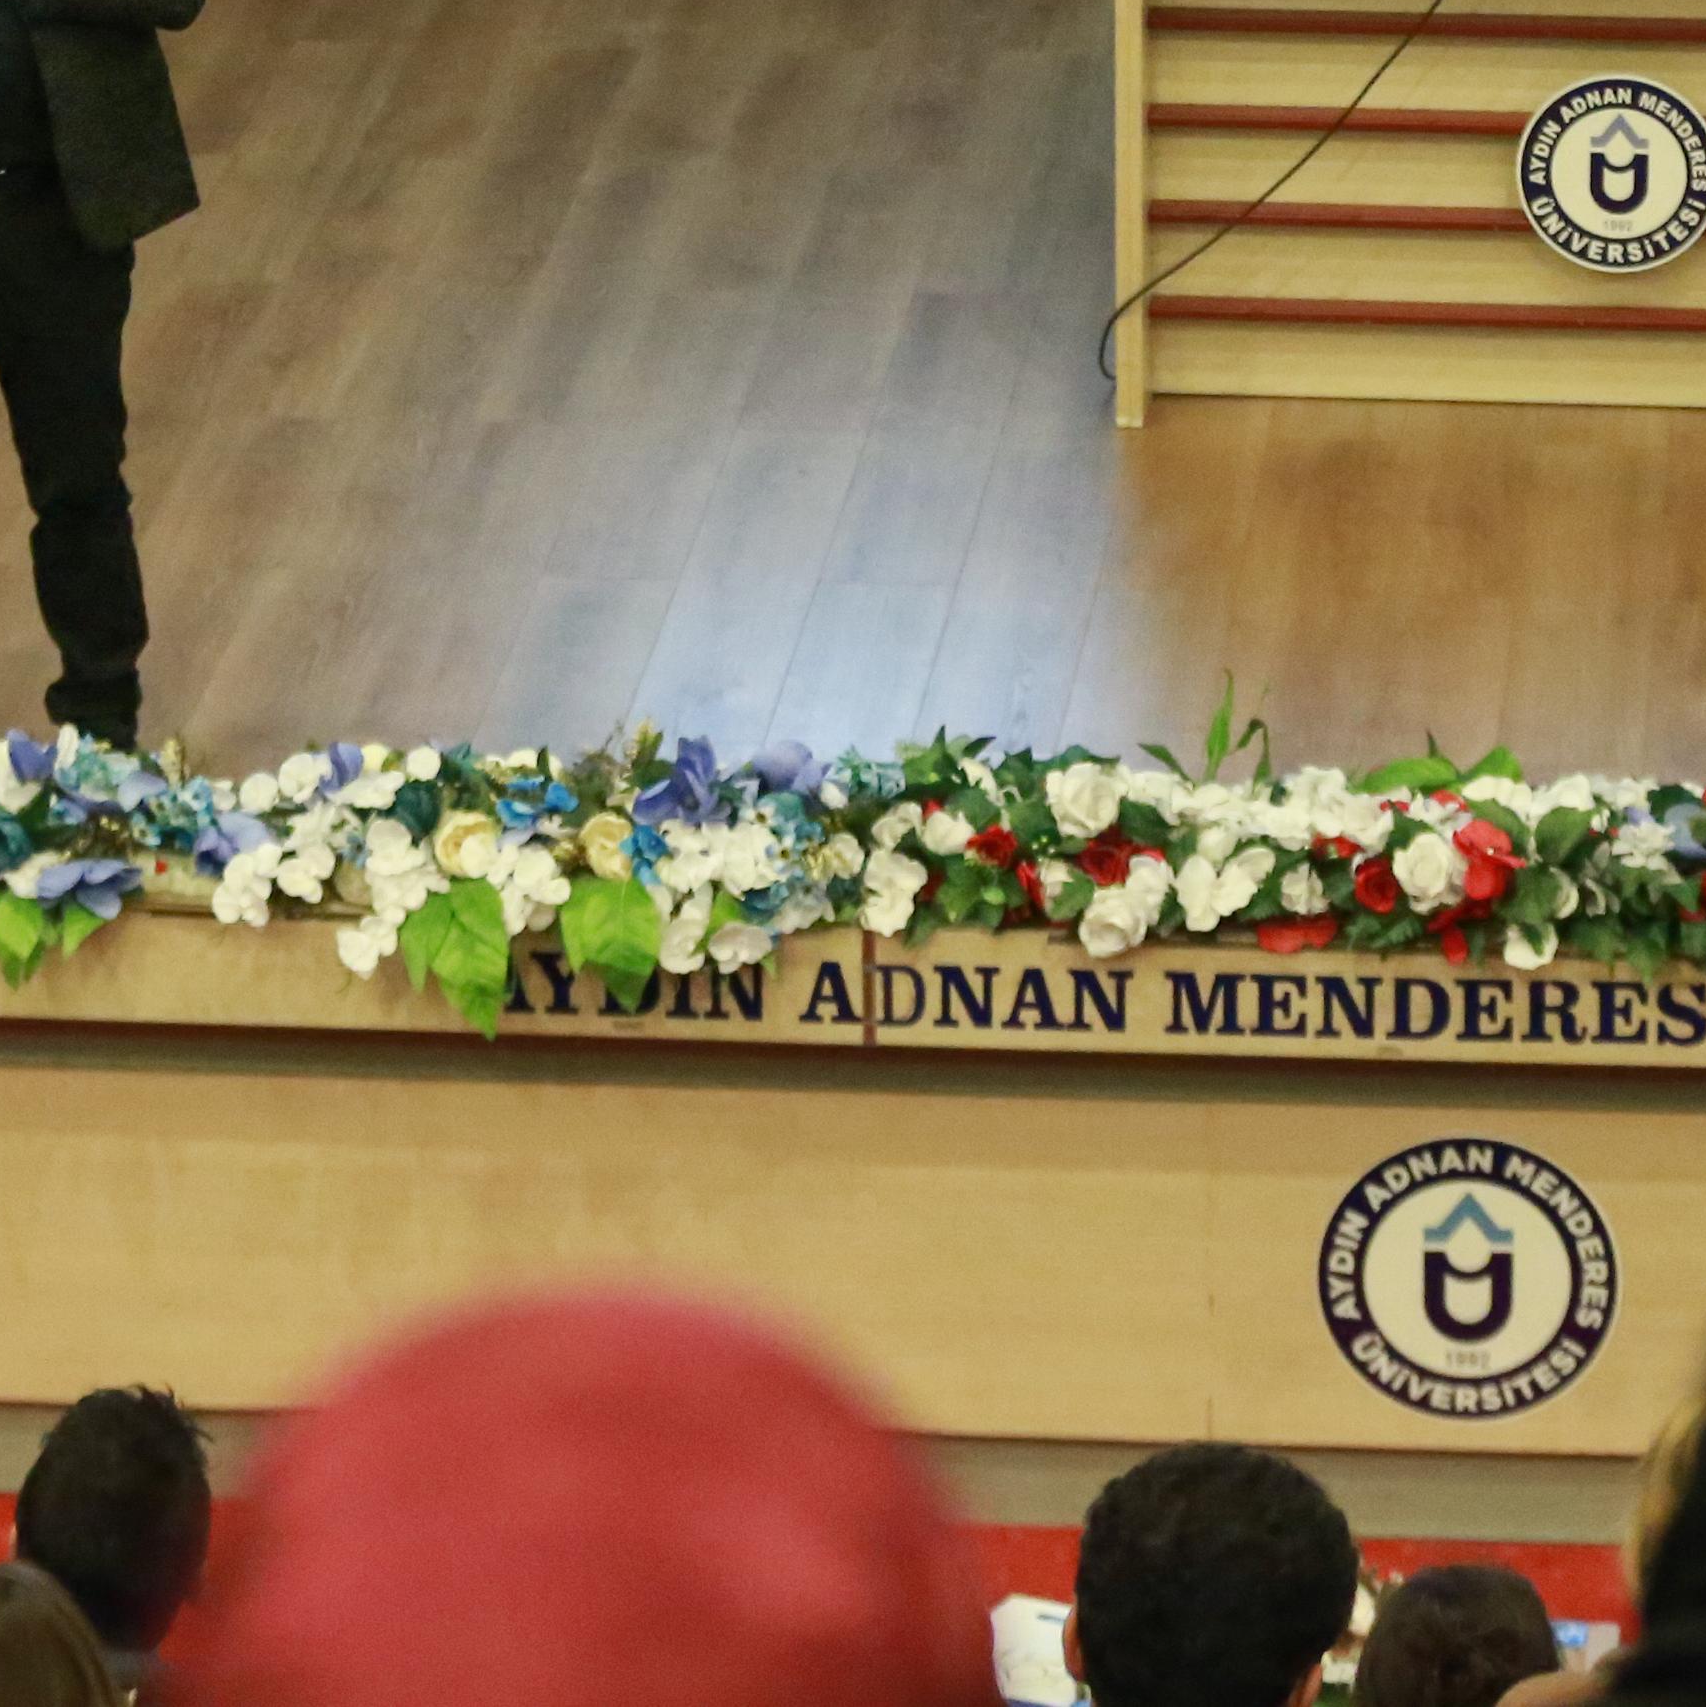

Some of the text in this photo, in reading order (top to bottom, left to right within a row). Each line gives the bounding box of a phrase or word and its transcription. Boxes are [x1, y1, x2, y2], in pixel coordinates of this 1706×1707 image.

[1529, 120, 1562, 186] AYDIN
[1560, 87, 1633, 124] ADNAN
[799, 961, 1134, 1033] ADNAN
[1328, 1145, 1610, 1330] AYDIN ADNAN MENDERES
